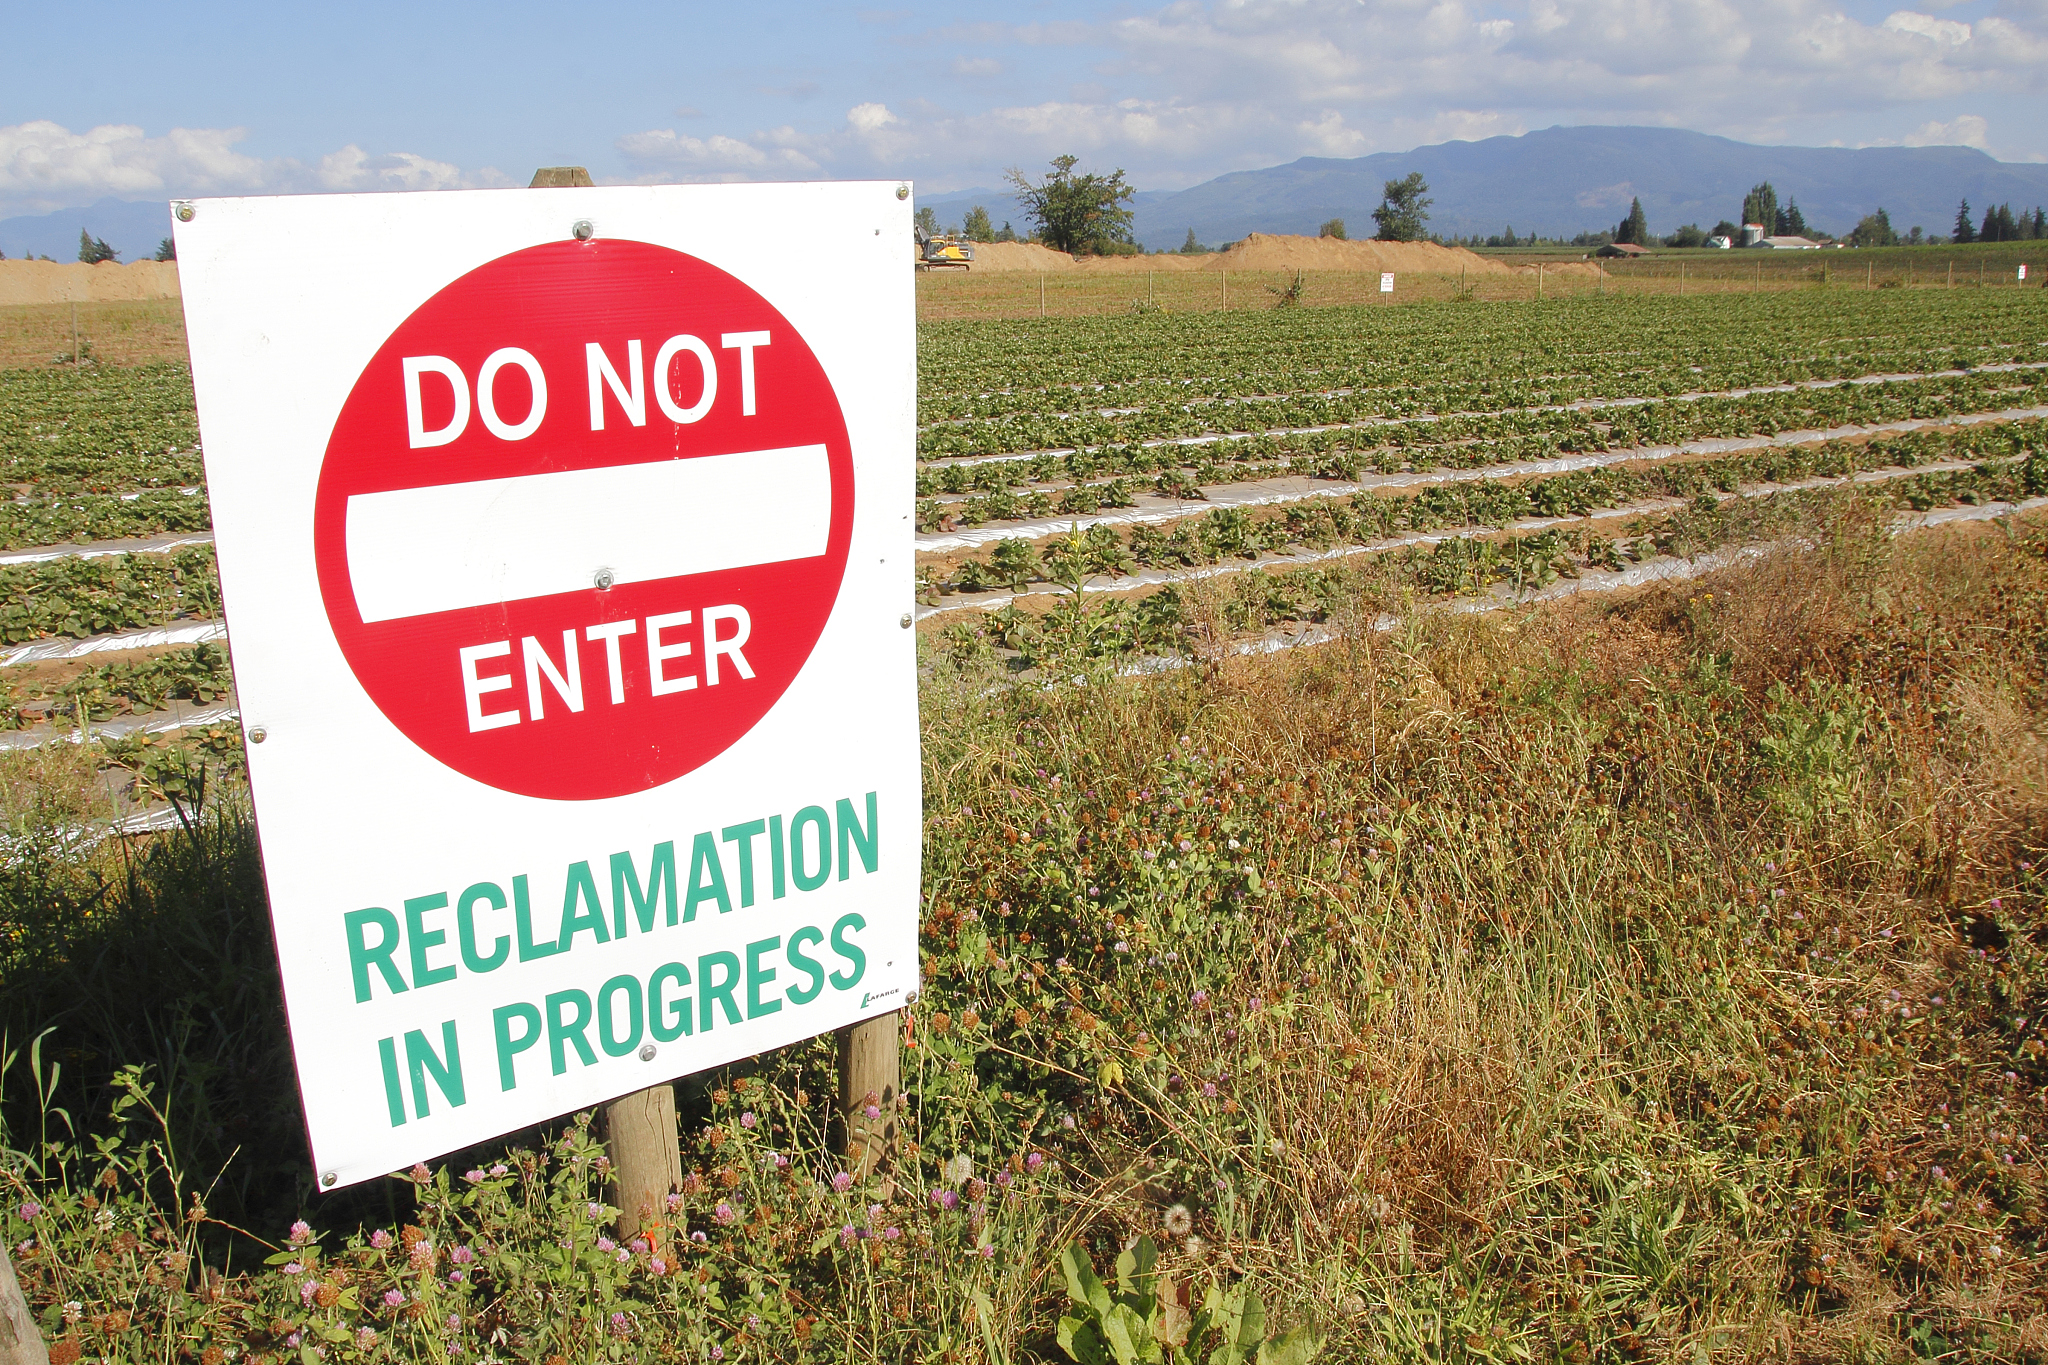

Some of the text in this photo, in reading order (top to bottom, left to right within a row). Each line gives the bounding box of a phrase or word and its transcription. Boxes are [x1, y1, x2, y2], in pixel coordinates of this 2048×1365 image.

[402, 329, 772, 450] DO NOT
[459, 603, 757, 734] ENTER
[343, 791, 878, 1004] RECLAMATION
[377, 913, 866, 1128] IN PROGRESS
